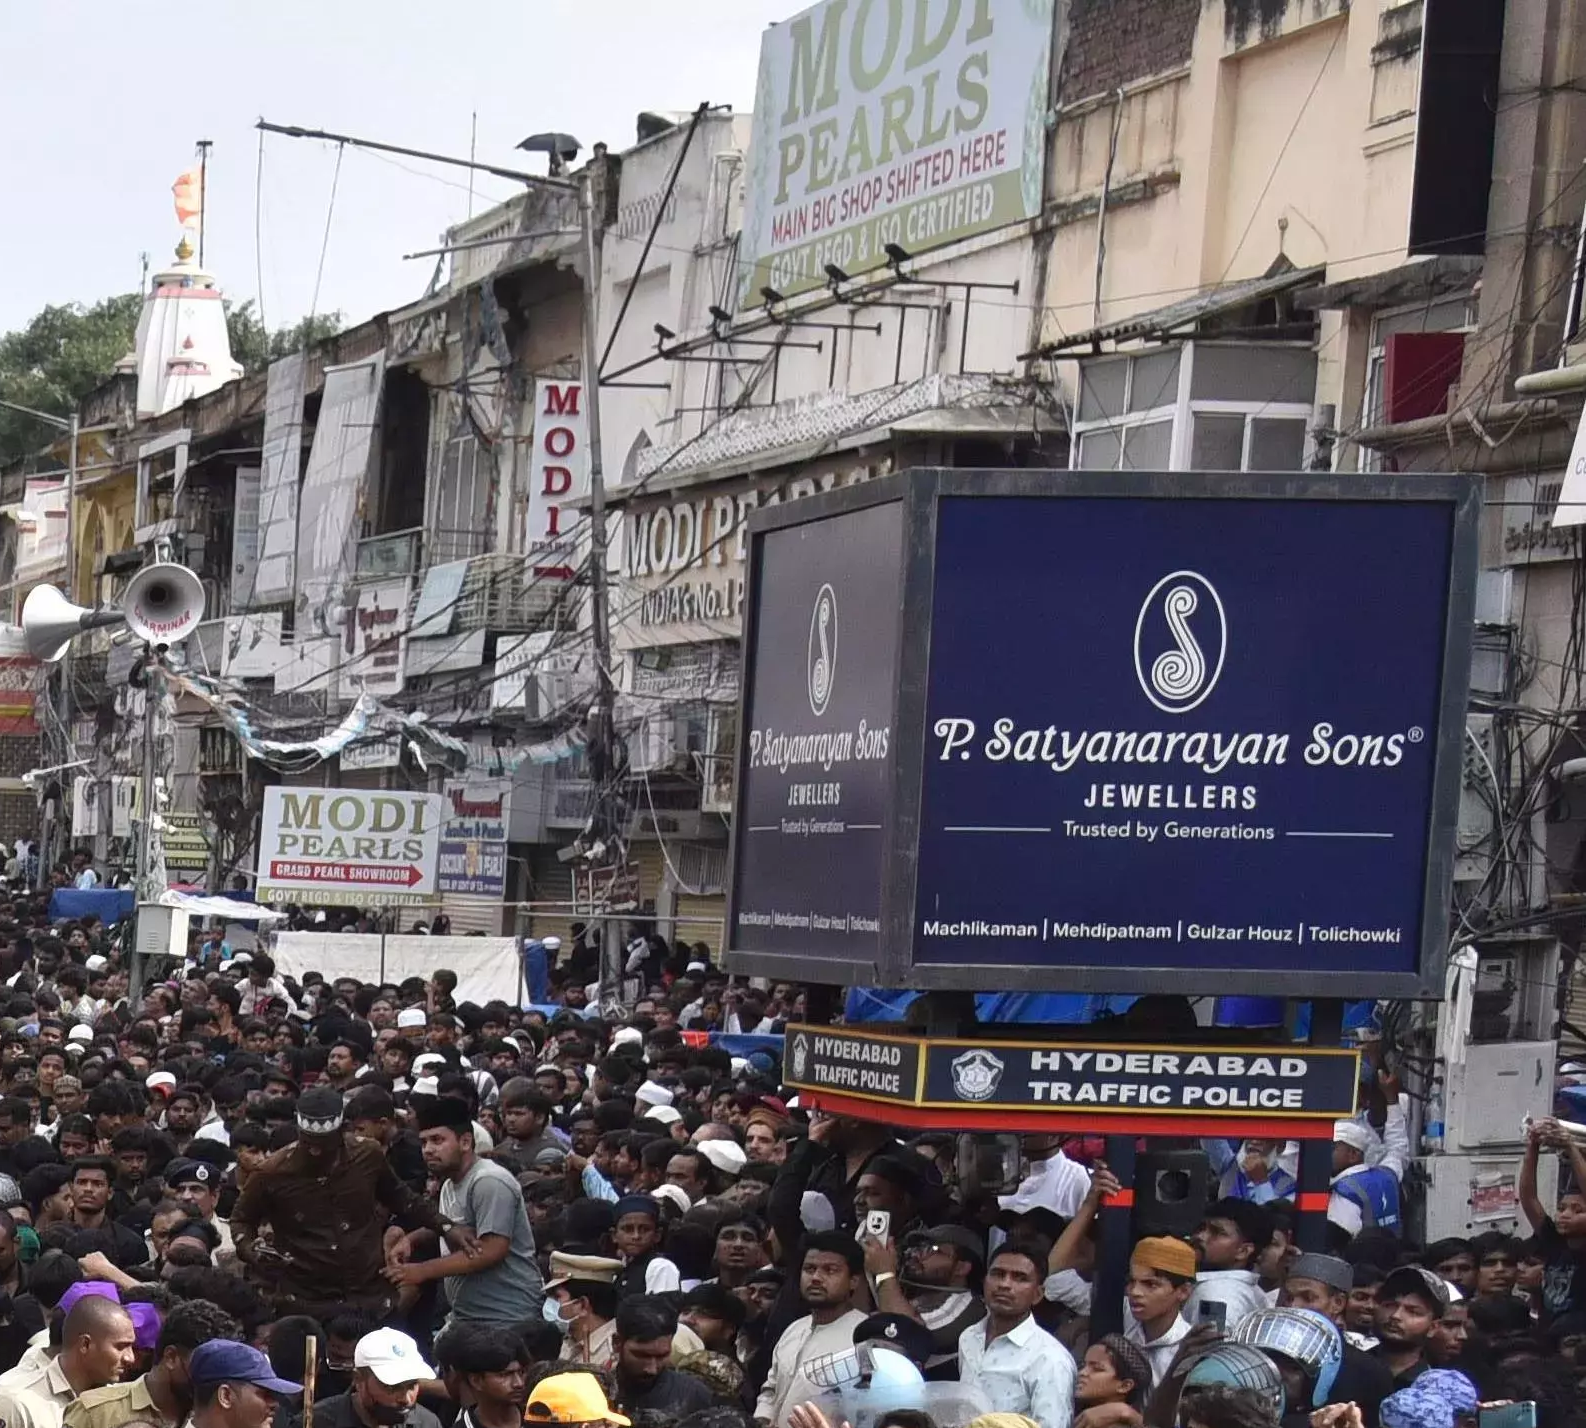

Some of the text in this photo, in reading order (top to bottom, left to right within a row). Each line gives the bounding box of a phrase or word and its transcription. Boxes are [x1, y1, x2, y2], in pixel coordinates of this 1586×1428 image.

[773, 50, 989, 206] PEARLS
[771, 129, 1007, 247] MAIN BIG SHOP SHIFTED HERE
[770, 251, 810, 290] GOVT
[858, 226, 868, 261] &
[875, 214, 901, 255] ISO
[906, 183, 995, 244] CERTIFIED
[541, 385, 582, 537] MODI
[626, 498, 704, 579] MODI
[134, 604, 191, 633] CHARMINAR
[749, 718, 890, 774] P. Satyanarayan Sons
[933, 717, 975, 761] P.
[984, 716, 1290, 774] Satyanarayan
[787, 783, 841, 806] JEWELLERS
[1083, 783, 1258, 810] JEWELLERS
[278, 793, 429, 836] MODI
[1063, 820, 1275, 842] Trusted by Generations
[276, 834, 424, 862] PEARLS
[276, 863, 411, 882] GRAND PEARL SHOWROOM
[267, 888, 298, 902] GOVT
[923, 920, 1402, 944] Machlikaman Mehdipatnam Gulzar Houz Tolichowki
[814, 1036, 902, 1066] HYDERABAD
[1030, 1050, 1309, 1078] HYDERABAD
[813, 1063, 900, 1093] TRAFFIC POLICE
[1027, 1081, 1304, 1109] TRAFFIC POLICE
